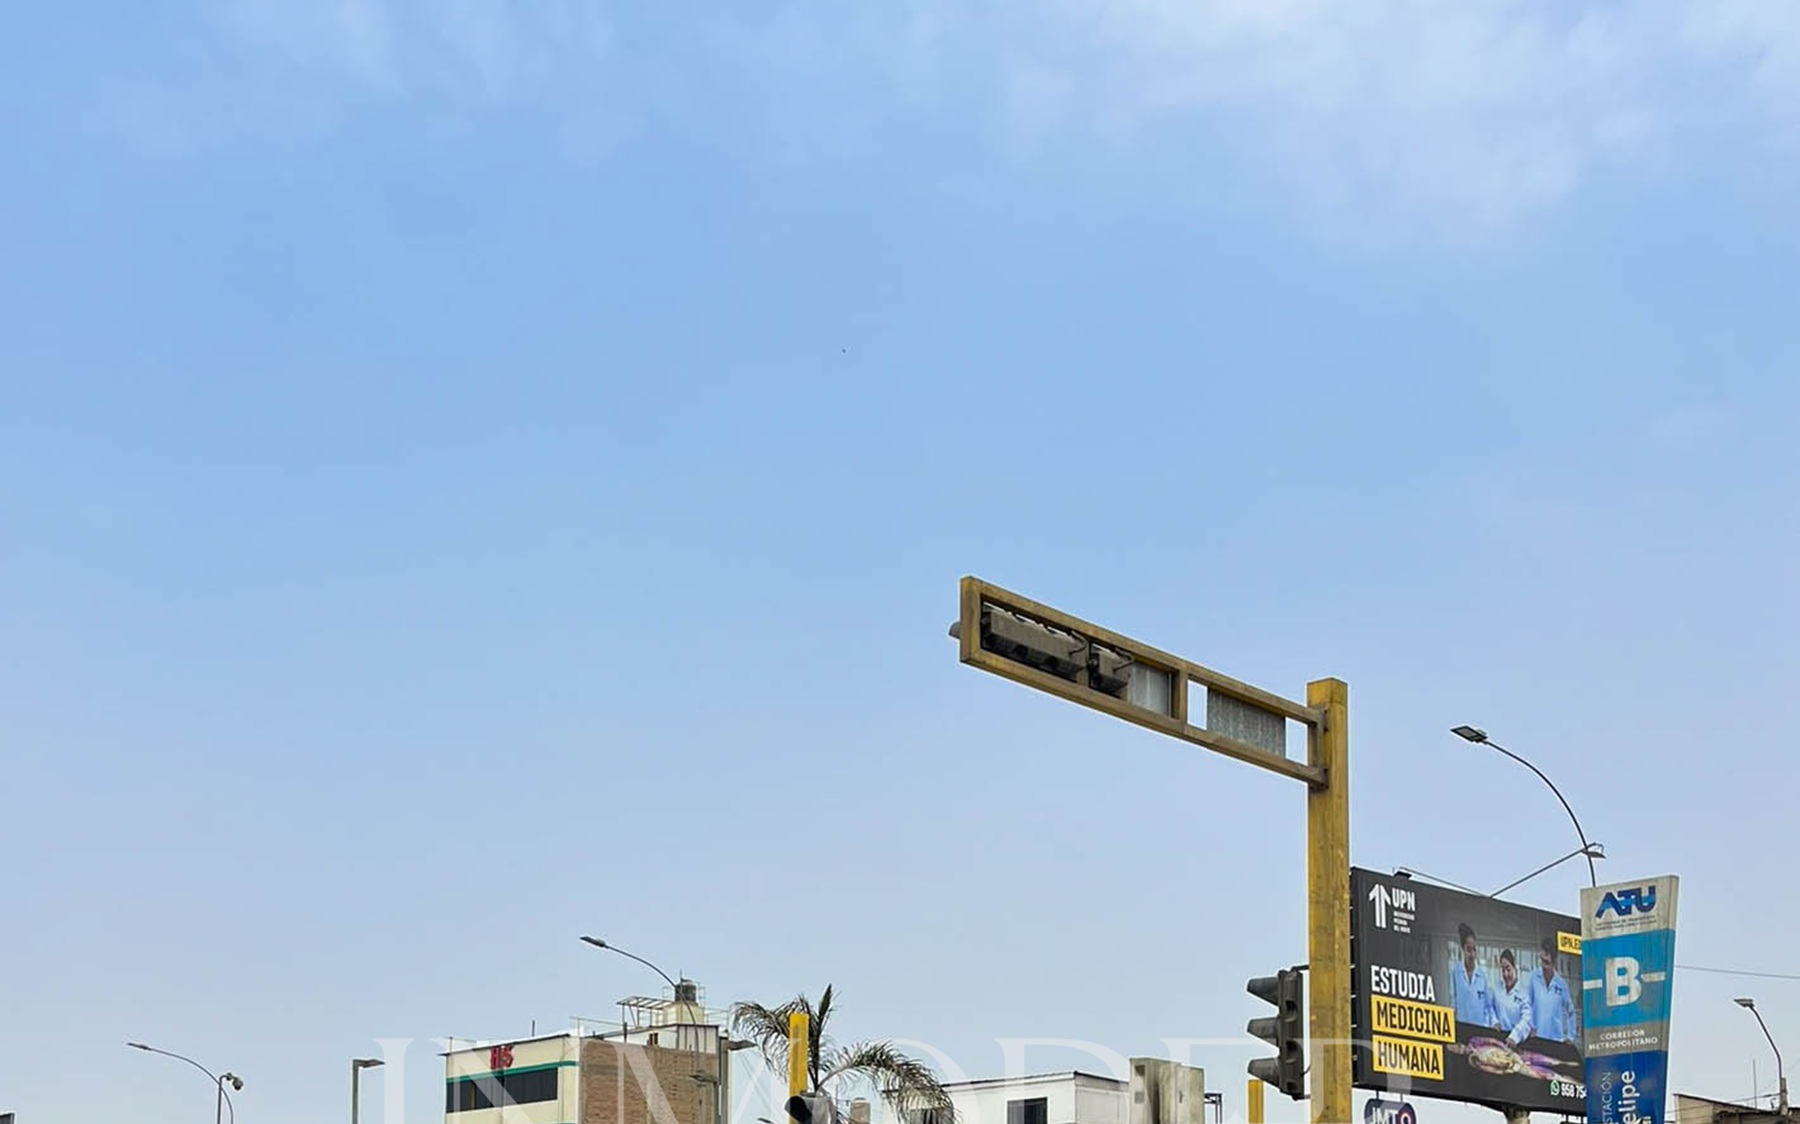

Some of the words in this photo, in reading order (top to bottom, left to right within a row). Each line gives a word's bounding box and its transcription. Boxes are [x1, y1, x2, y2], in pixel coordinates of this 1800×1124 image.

[1392, 887, 1415, 911] UPN
[1595, 886, 1656, 919] ATU
[1371, 964, 1436, 1002] ESTUDIA
[1606, 956, 1642, 1006] B
[1376, 1001, 1451, 1037] MEDICINA
[1378, 1040, 1441, 1075] HUMANA
